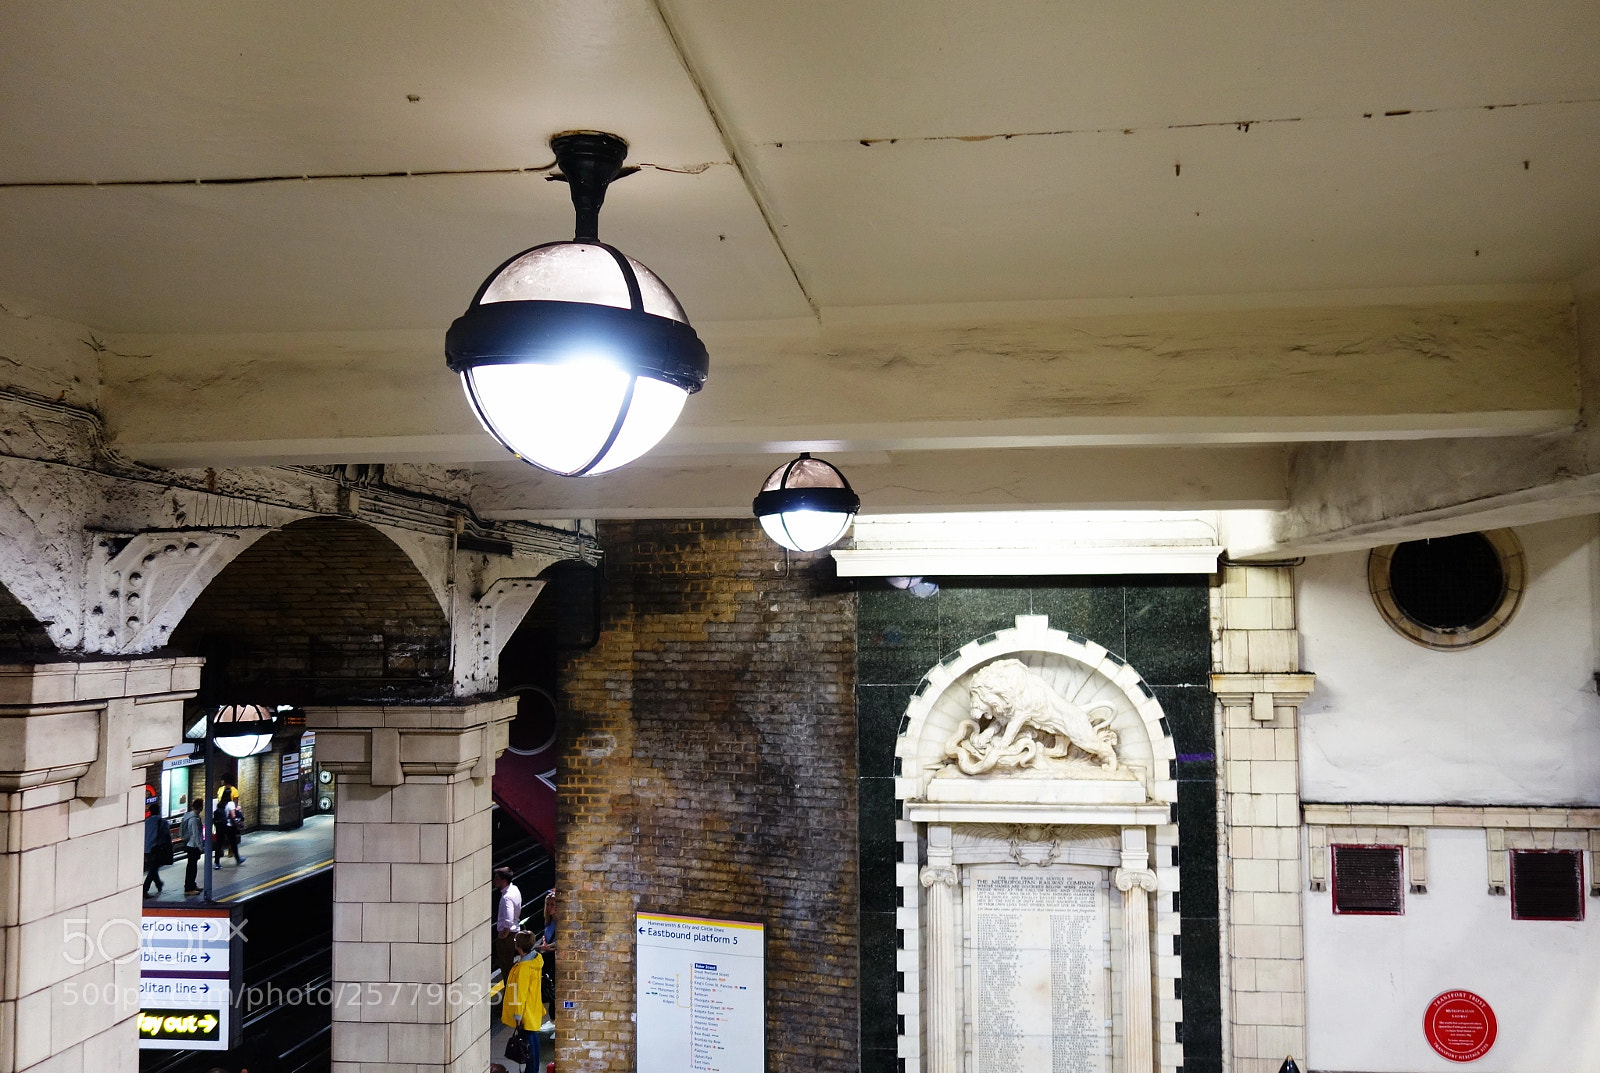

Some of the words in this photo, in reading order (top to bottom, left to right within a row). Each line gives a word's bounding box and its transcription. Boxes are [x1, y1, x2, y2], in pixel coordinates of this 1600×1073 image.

[142, 922, 173, 931] erloo
[177, 922, 198, 931] line
[648, 928, 691, 940] Eastbound
[693, 933, 730, 944] platform
[177, 952, 198, 962] line
[176, 983, 197, 993] line
[1434, 992, 1466, 1007] TRANSPORT
[1469, 994, 1486, 1007] TRUST
[164, 1015, 198, 1032] out
[1433, 1042, 1458, 1059] TRANSPORT
